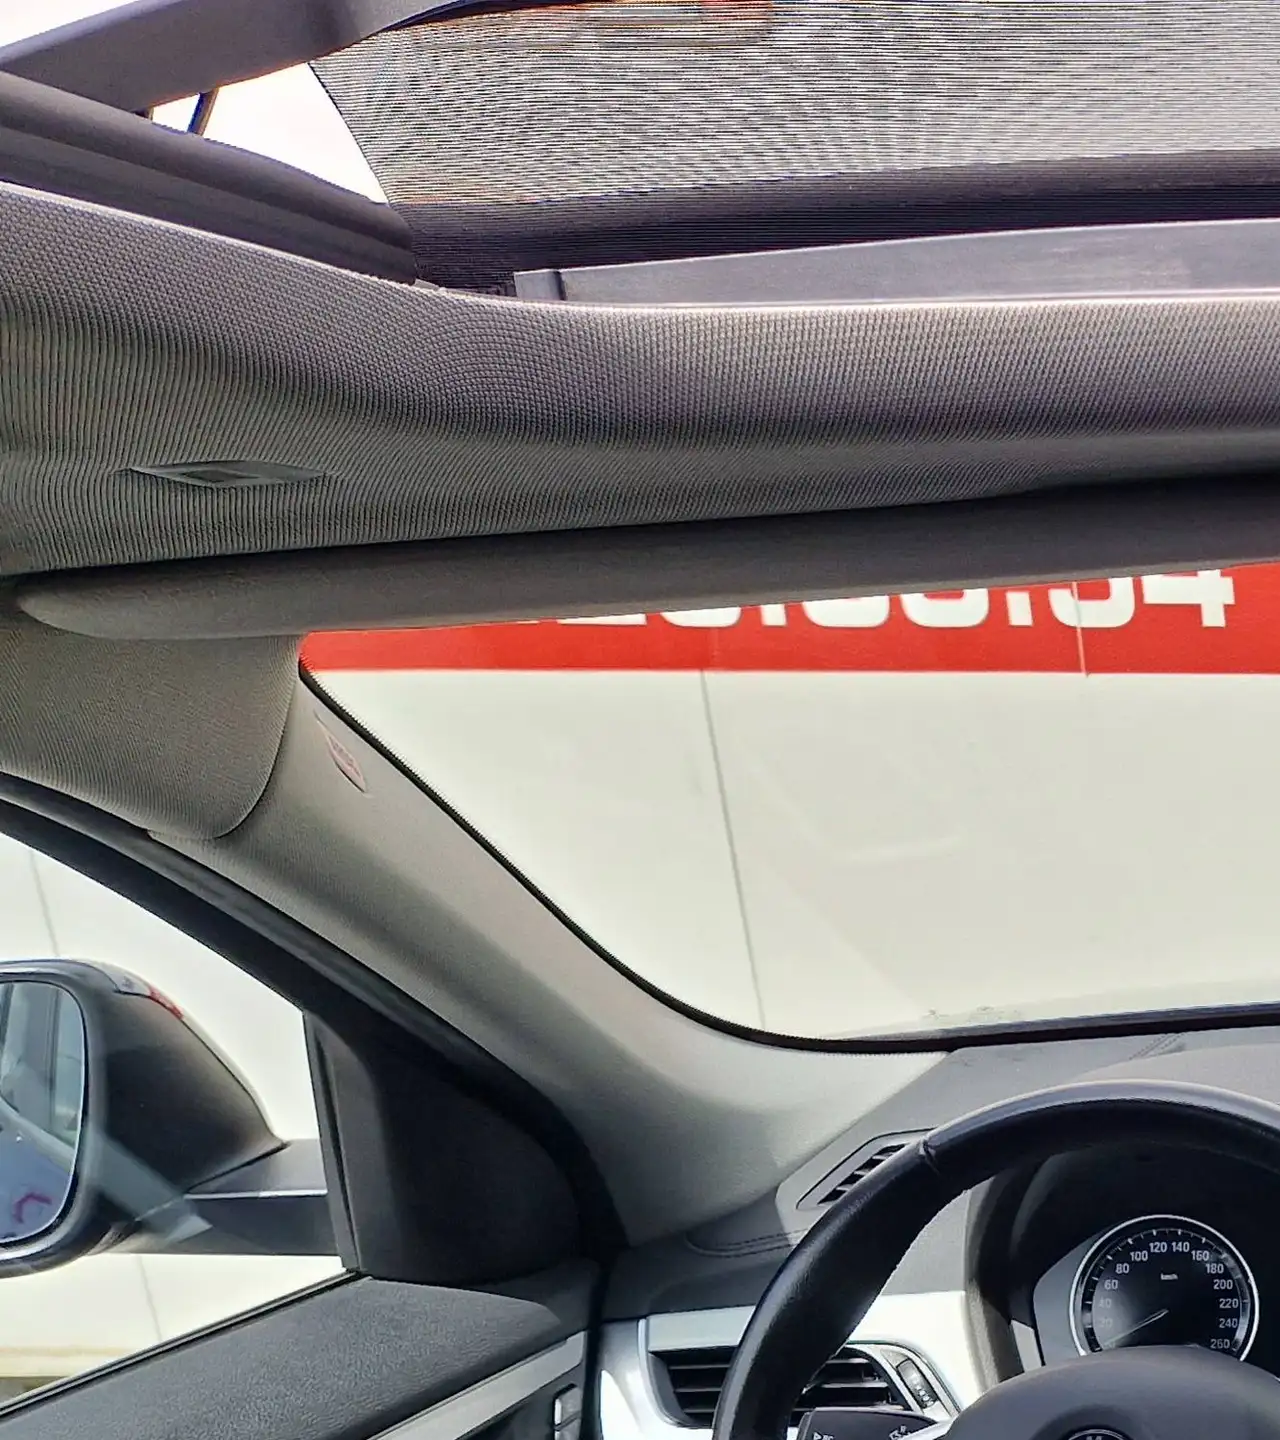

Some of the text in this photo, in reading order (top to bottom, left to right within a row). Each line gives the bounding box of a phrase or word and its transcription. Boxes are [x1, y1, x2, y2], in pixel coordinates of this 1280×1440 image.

[1150, 1242, 1168, 1252] 120
[1172, 1241, 1190, 1252] 140
[1130, 1251, 1148, 1262] 100
[1191, 1250, 1209, 1261] 160
[1115, 1263, 1130, 1274] 80
[1205, 1263, 1224, 1274] 180
[1104, 1279, 1119, 1290] 60
[1213, 1279, 1233, 1290] 200
[1219, 1298, 1239, 1309] 220
[1219, 1318, 1238, 1329] 240
[1210, 1338, 1230, 1349] 260
